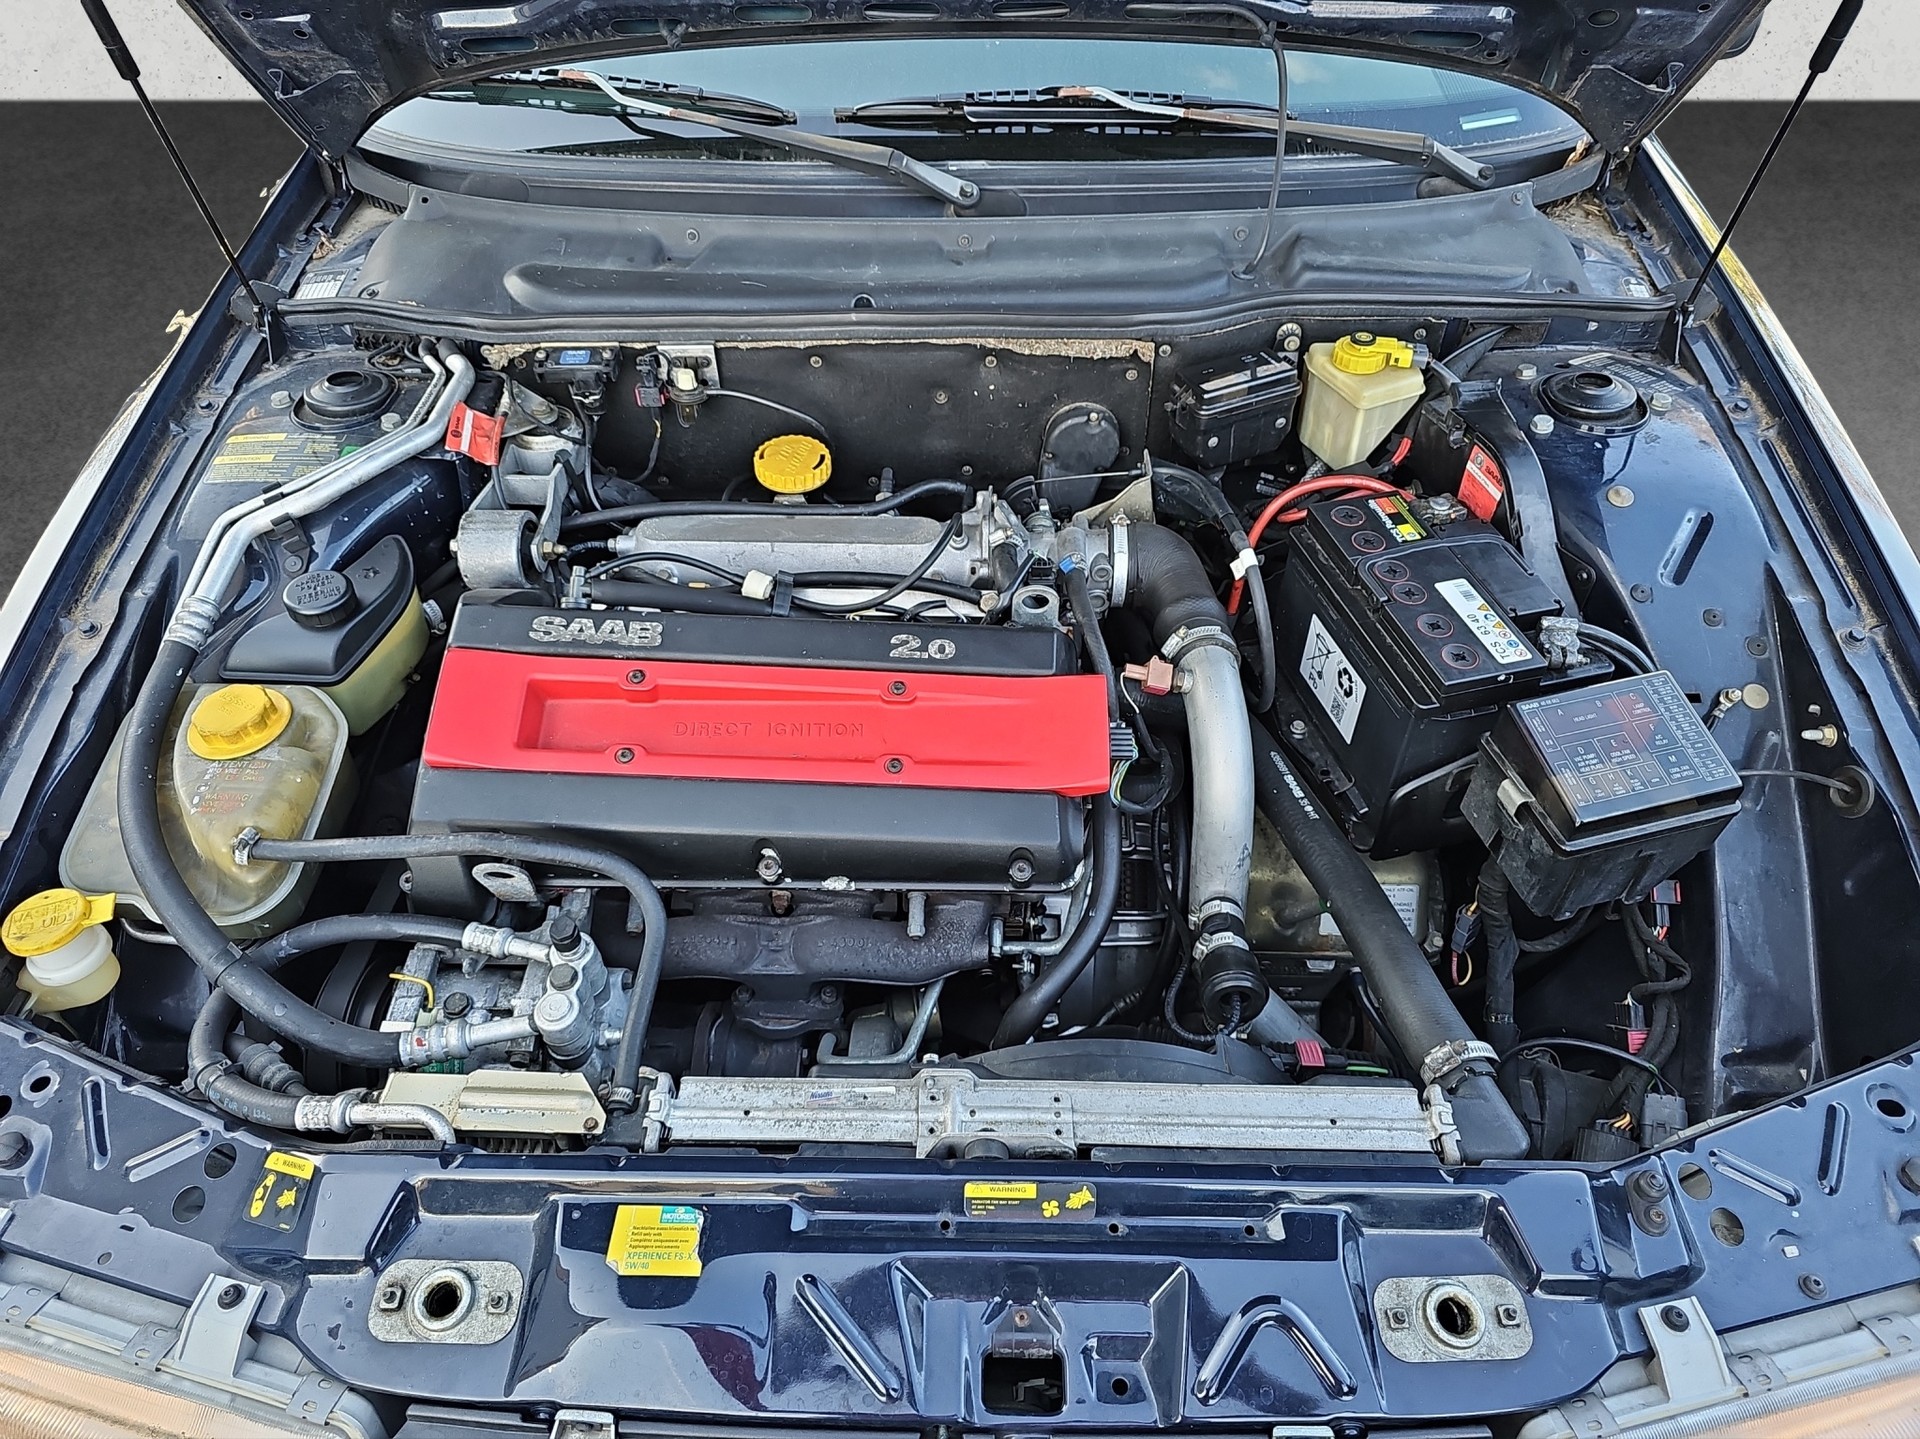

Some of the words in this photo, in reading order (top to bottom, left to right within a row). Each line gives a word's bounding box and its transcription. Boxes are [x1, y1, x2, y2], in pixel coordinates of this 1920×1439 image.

[1485, 466, 1503, 487] SAAB
[528, 616, 664, 648] SAAB
[889, 634, 957, 660] 2.0
[1490, 641, 1511, 660] TCS
[673, 721, 752, 738] DIRECT
[767, 722, 866, 738] IGNITION
[1283, 774, 1305, 798] SAAB
[282, 1159, 306, 1171] WARNING
[674, 1252, 692, 1260] FS-X
